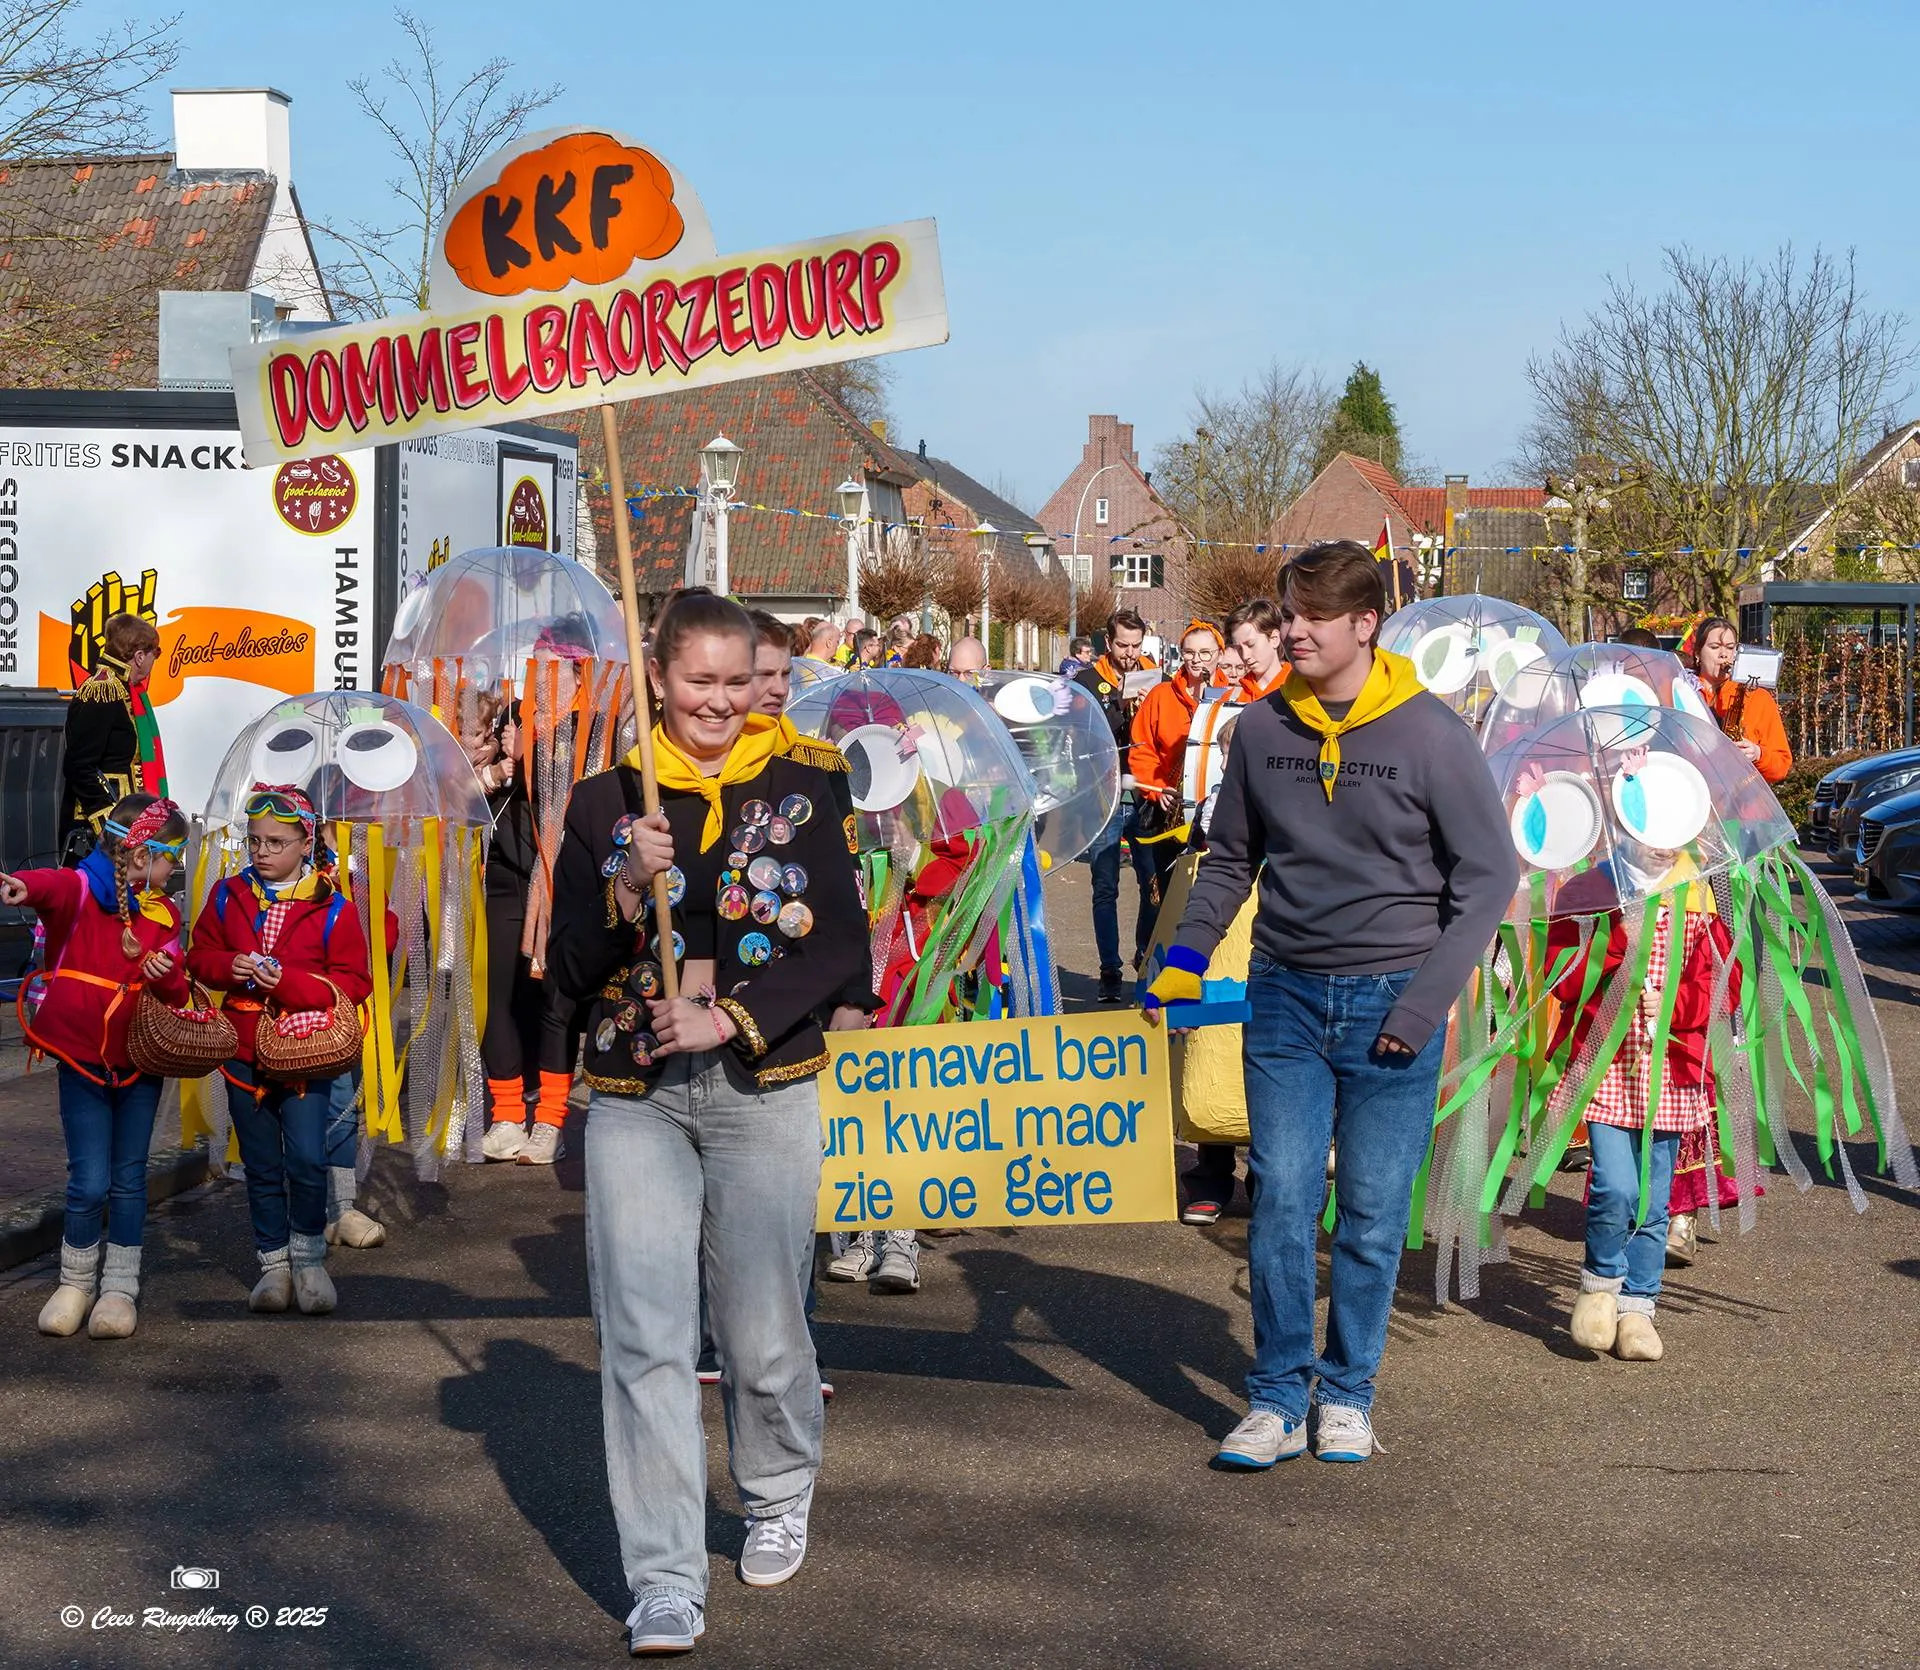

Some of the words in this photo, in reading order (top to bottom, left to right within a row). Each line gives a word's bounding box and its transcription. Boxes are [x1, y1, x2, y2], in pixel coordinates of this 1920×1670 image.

[482, 164, 633, 278] KKF
[269, 241, 900, 447] DOMMELBAORZEDURP
[0, 442, 101, 468] FRITES
[283, 482, 348, 501] food-classics
[0, 478, 18, 673] BROODJES
[169, 626, 308, 678] food-classics
[1266, 756, 1398, 781] RETROECTIVE
[1055, 1025, 1147, 1081] ben
[1016, 1100, 1145, 1149] maor
[834, 1171, 894, 1223] zie
[919, 1176, 977, 1220] oe
[1005, 1154, 1113, 1217] gère
